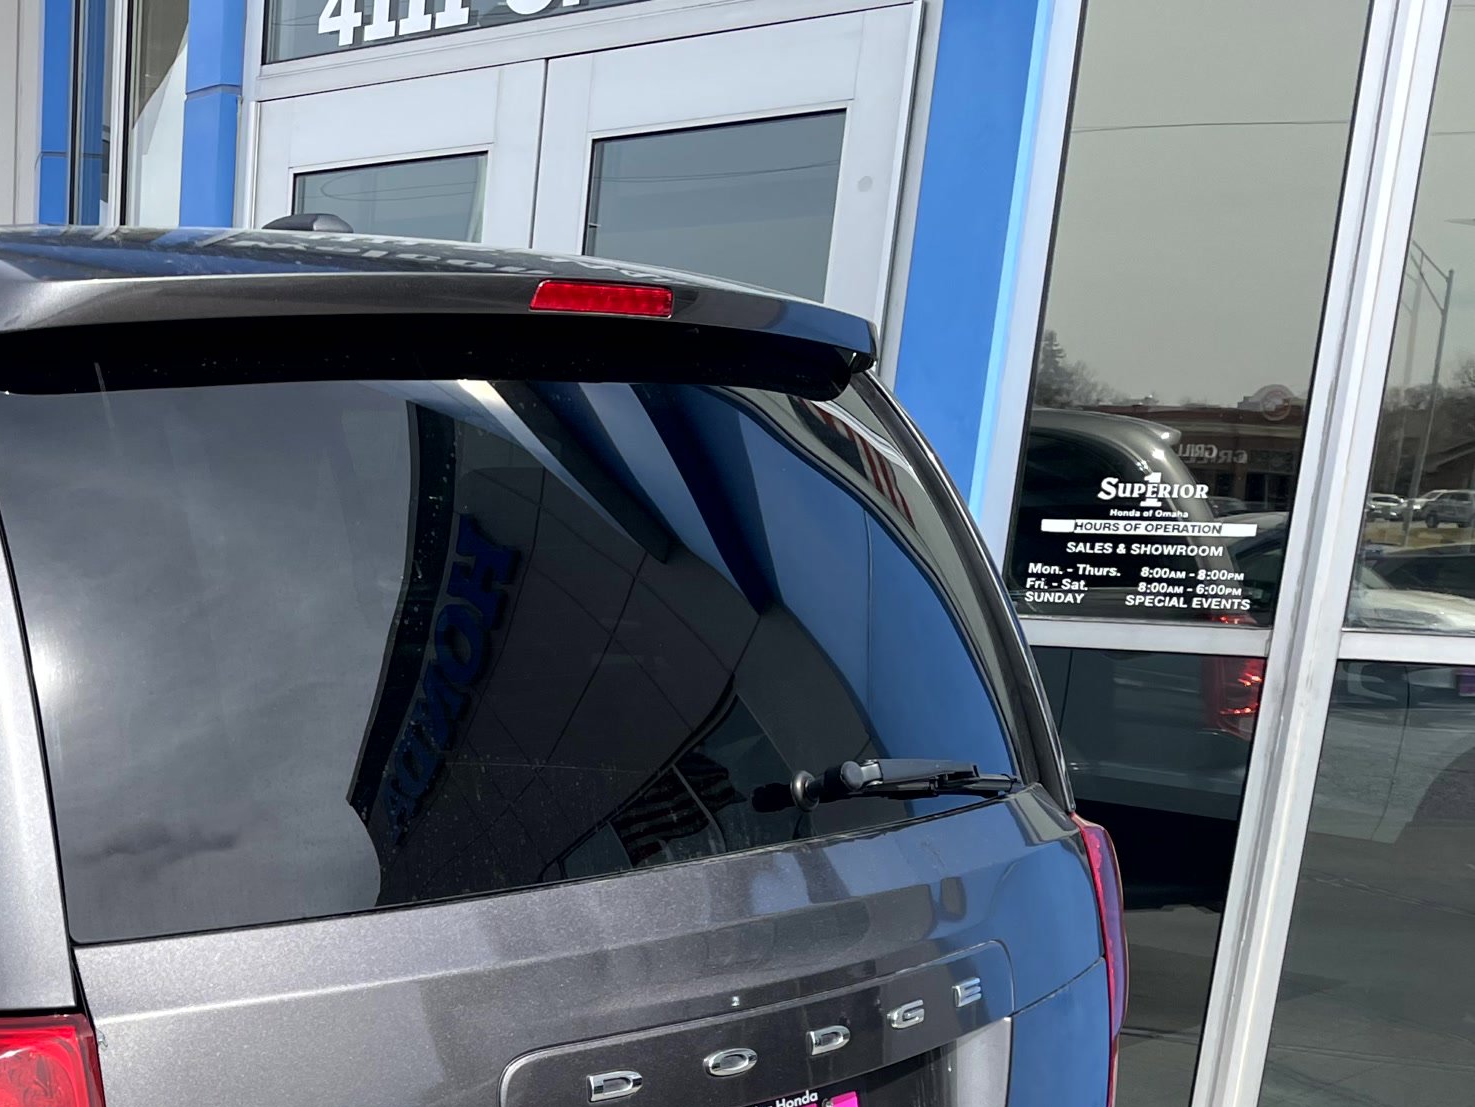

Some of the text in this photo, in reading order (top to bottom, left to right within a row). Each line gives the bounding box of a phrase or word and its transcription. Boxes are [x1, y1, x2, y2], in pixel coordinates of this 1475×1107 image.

[1097, 477, 1209, 500] SUPERIOR
[1109, 509, 1189, 518] Honda of Omaha
[1074, 521, 1222, 534] HOURS OF OPERATION
[1066, 541, 1224, 556] SALES & SHOWROOM
[1028, 562, 1064, 574] Mon.
[1077, 564, 1121, 576] Thurs.
[1140, 567, 1186, 579] 8:00AM
[1197, 569, 1245, 581] 8:00PM
[1025, 577, 1048, 588] Fri.
[1061, 578, 1089, 590] Sat.
[1138, 582, 1184, 594] 8:00AM
[1196, 584, 1242, 596] 6:00PM
[1024, 592, 1084, 603] SUNDAY
[1125, 595, 1251, 610] SPECIAL EVENTS
[587, 977, 982, 1102] DODGE
